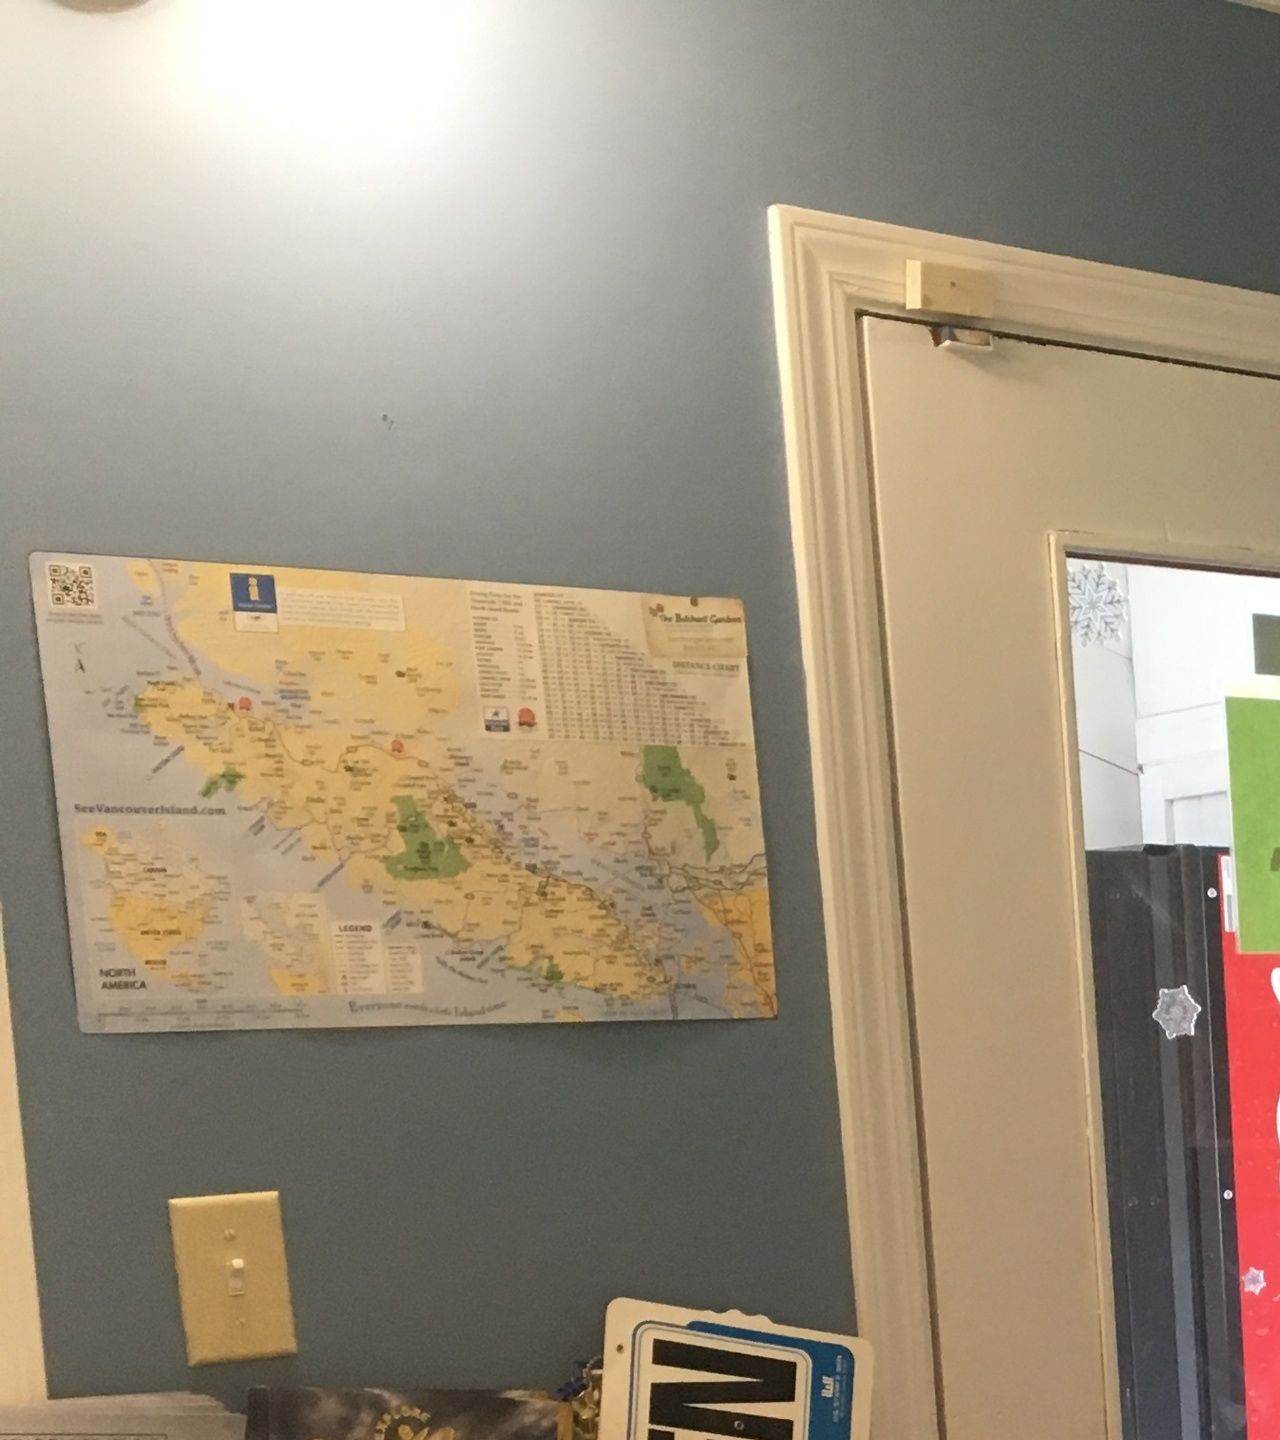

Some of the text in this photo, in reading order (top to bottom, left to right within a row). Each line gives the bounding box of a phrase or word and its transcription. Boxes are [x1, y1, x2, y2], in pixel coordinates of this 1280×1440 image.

[74, 803, 226, 816] SeeVancouverIsland.com
[99, 968, 136, 978] NORTH
[101, 980, 147, 990] AMERICA
[373, 1405, 432, 1440] EXPLORE
